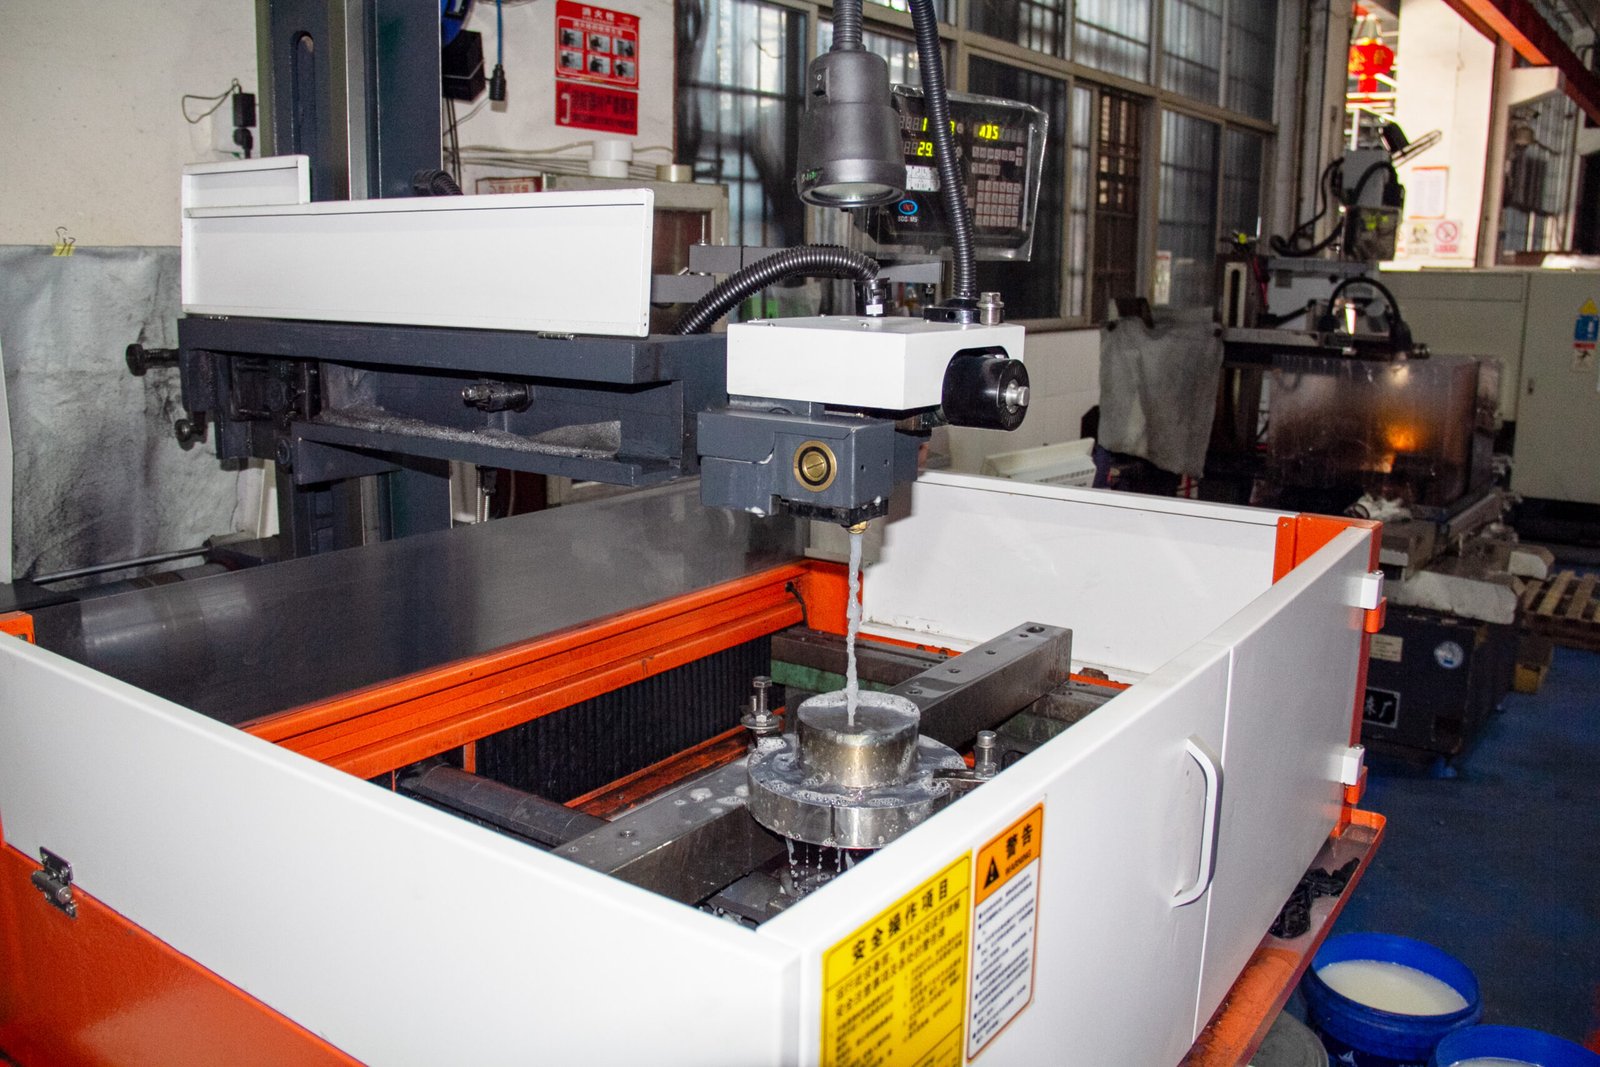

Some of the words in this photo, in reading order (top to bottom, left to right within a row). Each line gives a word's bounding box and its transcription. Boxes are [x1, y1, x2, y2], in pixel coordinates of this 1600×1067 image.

[1006, 823, 1032, 860] 警告
[852, 879, 948, 965] 安全操作项目
